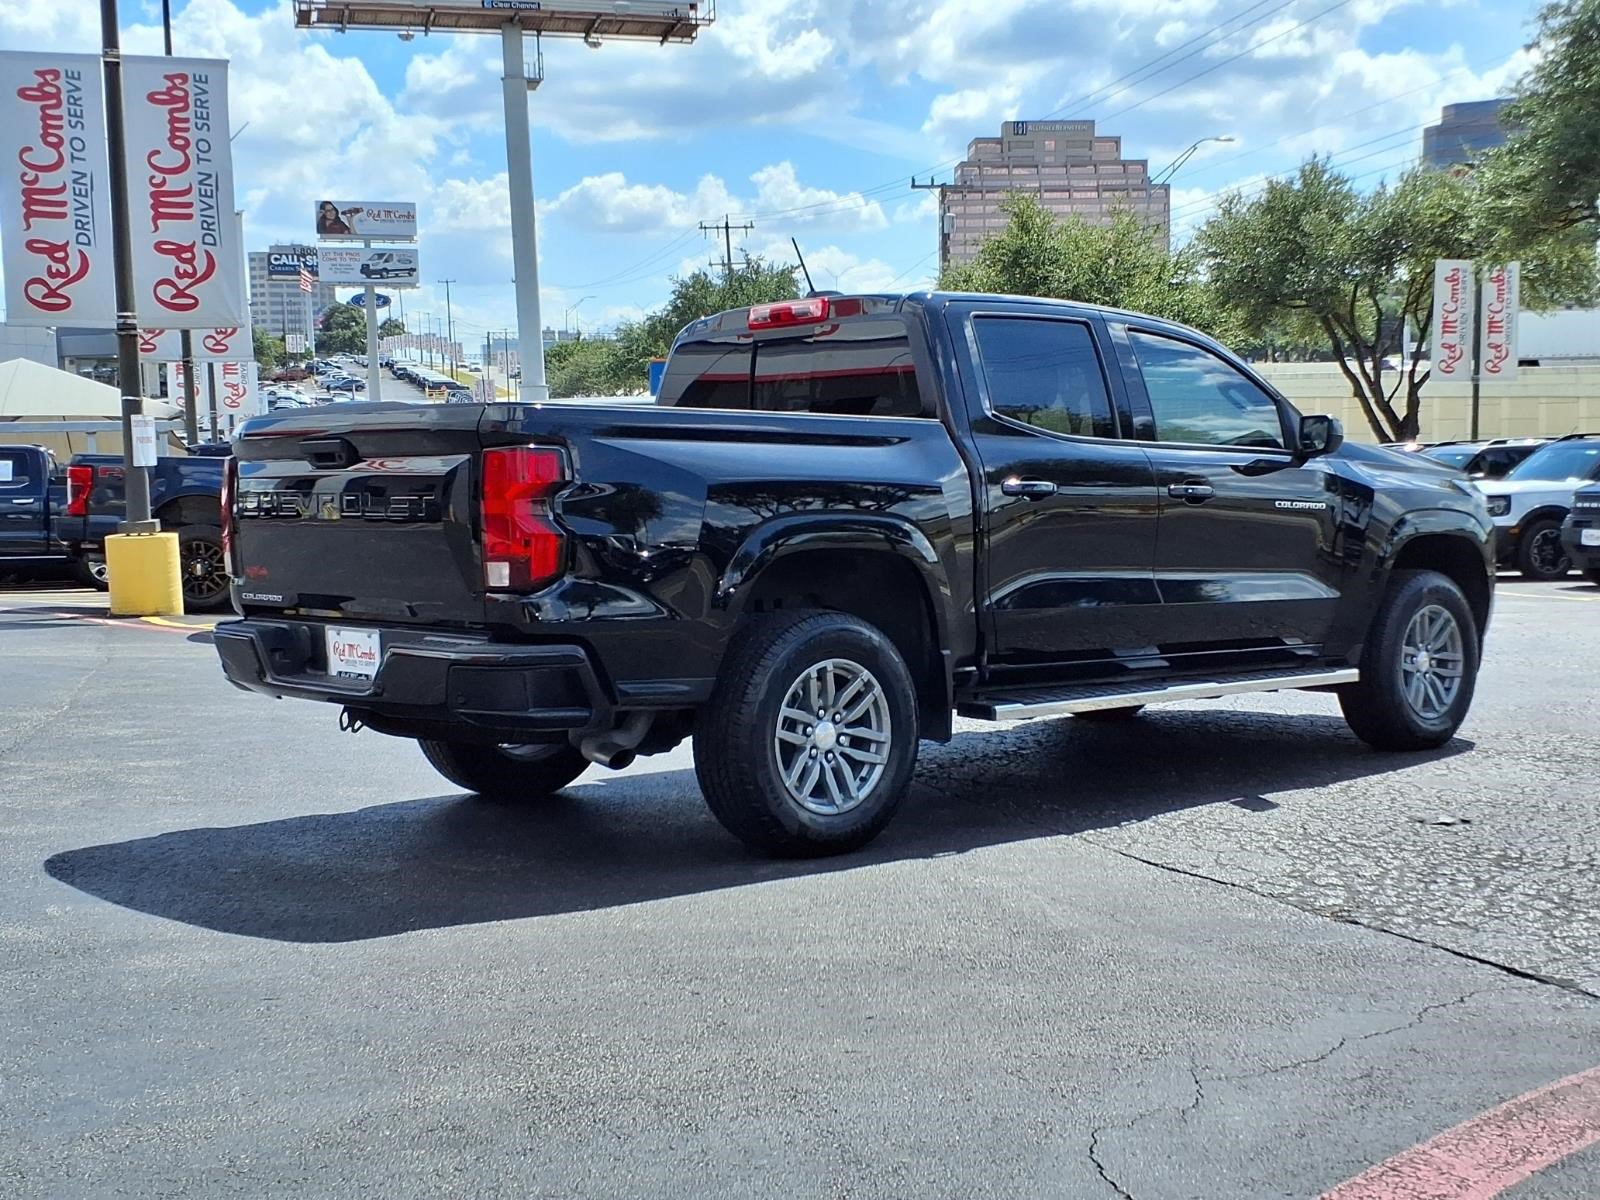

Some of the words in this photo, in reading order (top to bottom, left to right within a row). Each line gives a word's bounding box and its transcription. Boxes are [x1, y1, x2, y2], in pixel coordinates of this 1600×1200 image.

[65, 68, 85, 131] SERVE
[192, 73, 211, 132] SERVE
[68, 136, 86, 165] TO
[195, 137, 213, 164] TO
[72, 171, 92, 248] DRIVEN
[198, 171, 218, 248] DRIVEN
[23, 238, 89, 312] Red
[152, 240, 216, 312] Red
[203, 327, 238, 354] Re
[1438, 342, 1463, 374] Red
[1485, 342, 1509, 374] Red
[223, 382, 247, 408] Red
[1275, 500, 1326, 510] COLORADO
[242, 592, 283, 602] COLORADO
